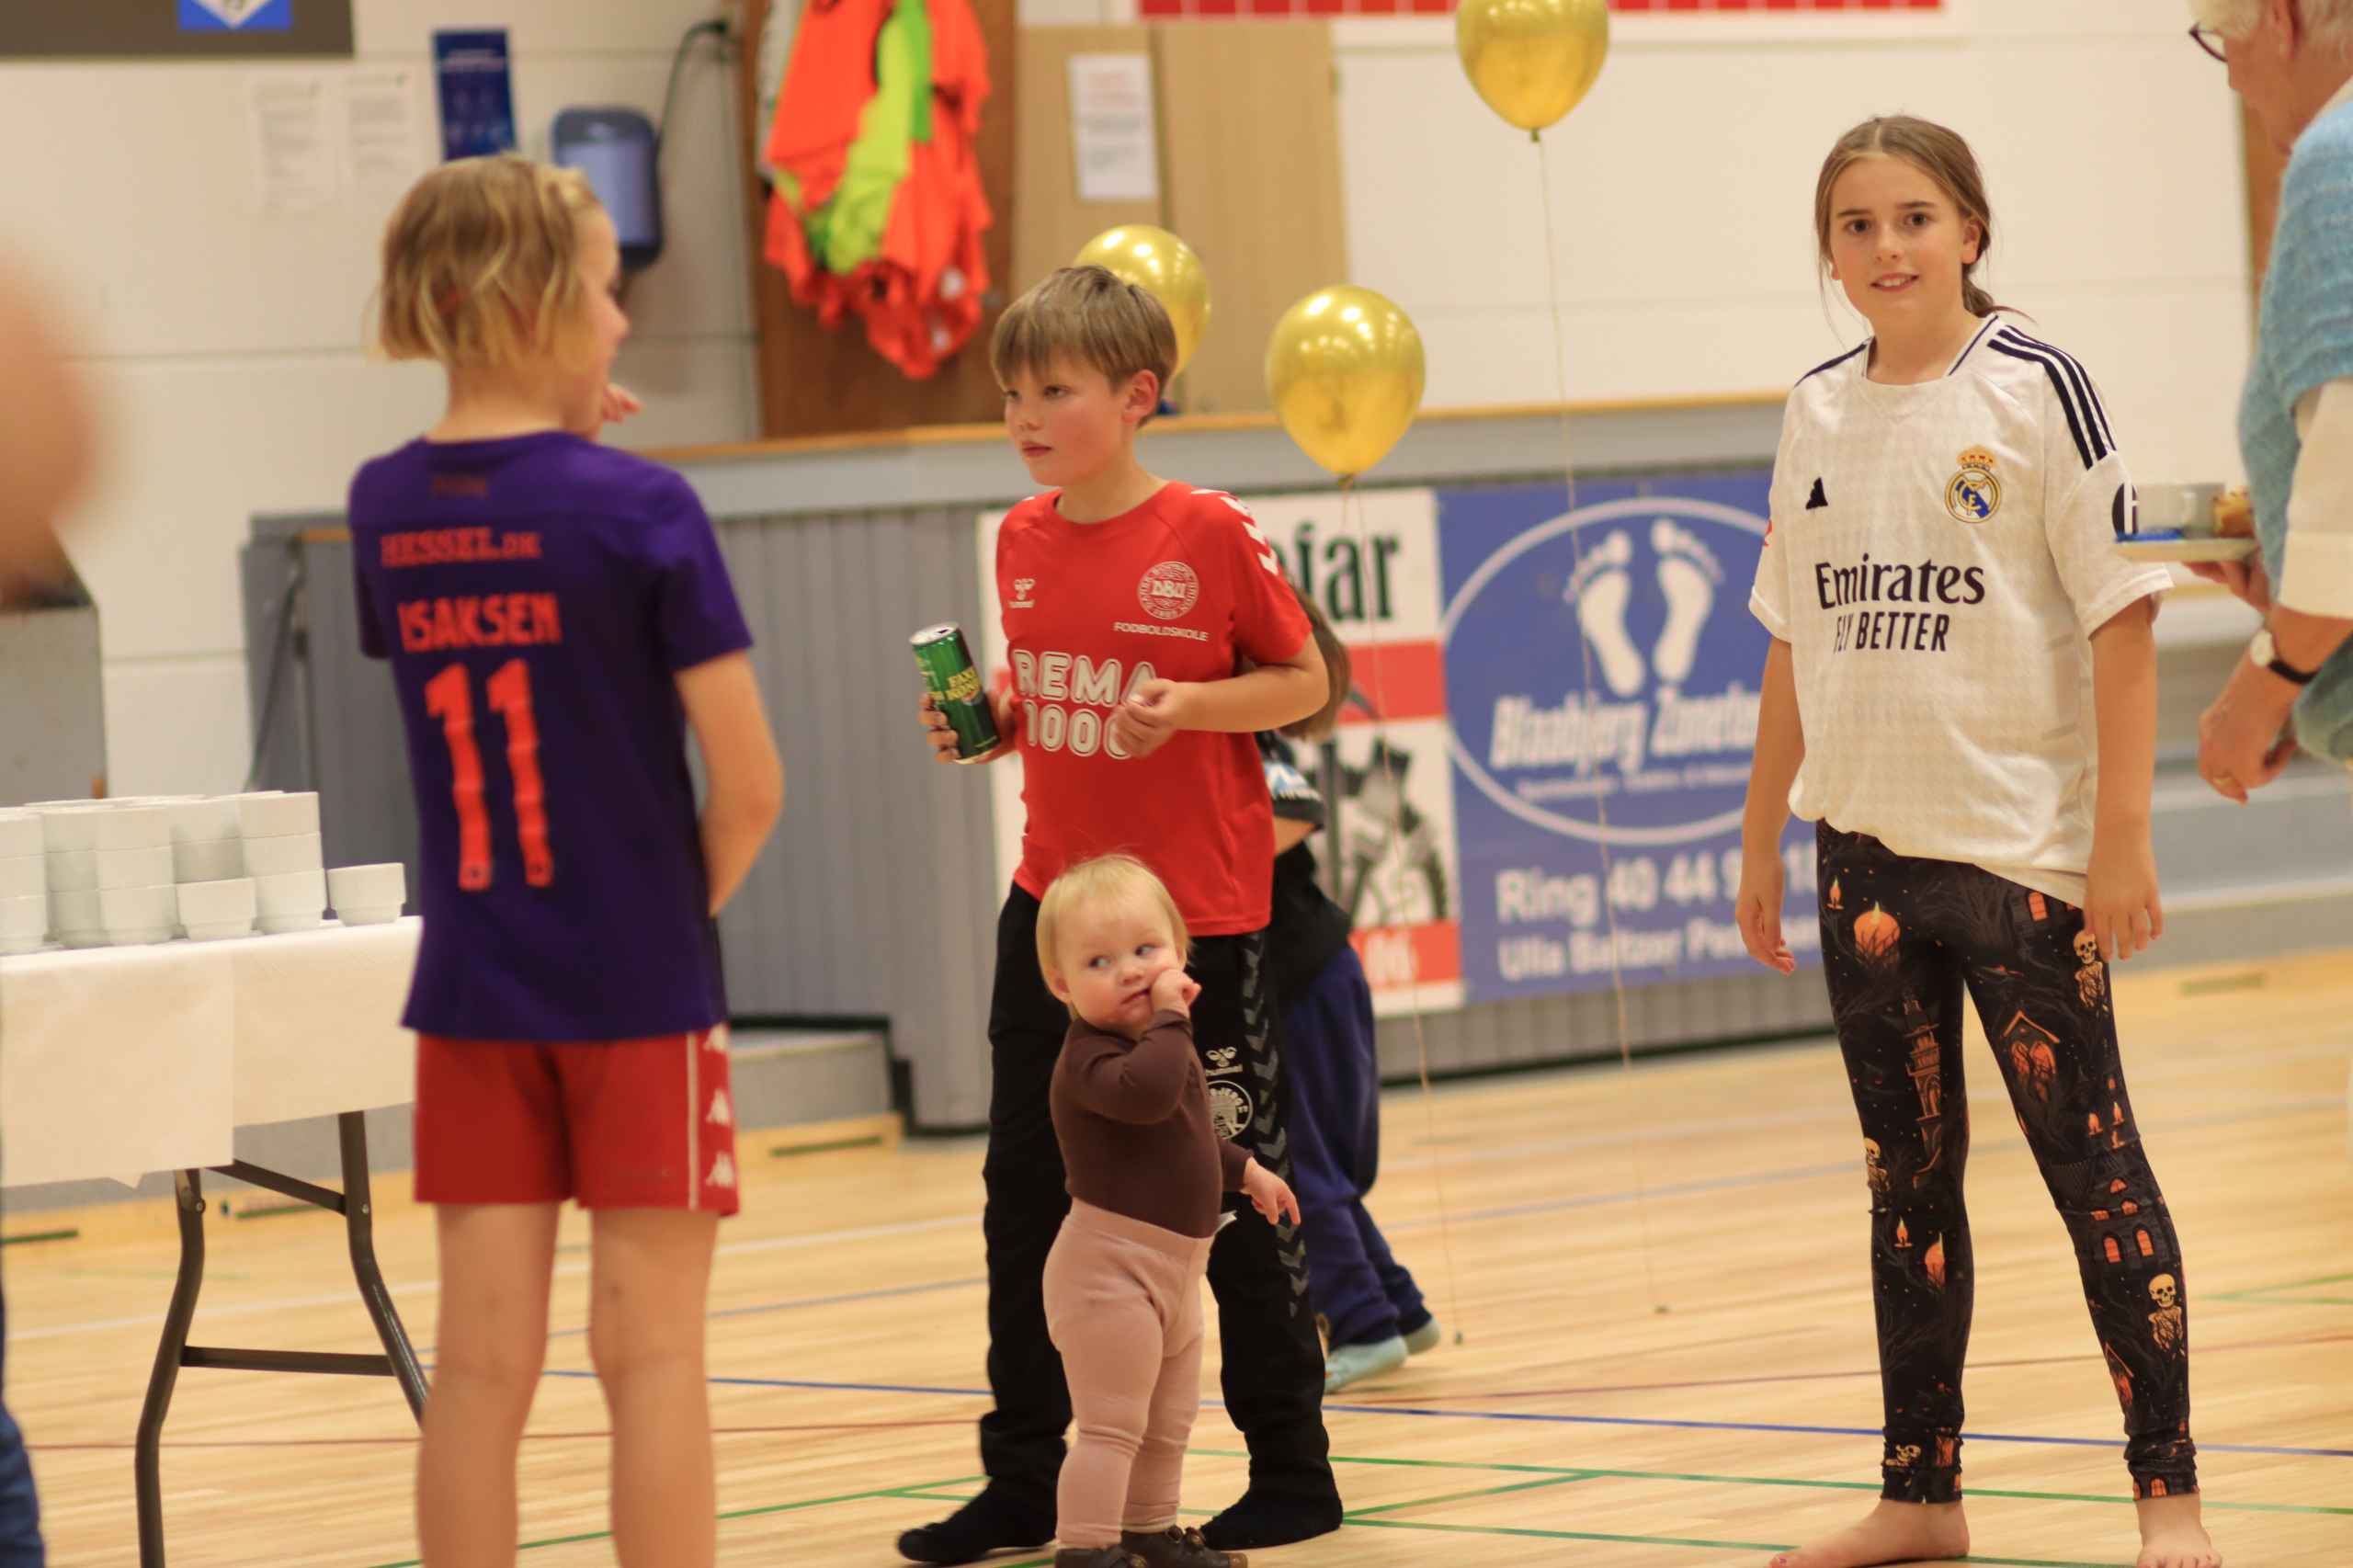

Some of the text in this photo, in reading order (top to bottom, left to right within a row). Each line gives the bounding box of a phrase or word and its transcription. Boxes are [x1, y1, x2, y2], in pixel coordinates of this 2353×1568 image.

[1815, 552, 1985, 609] Emirates
[397, 592, 563, 653] ISAKSEN
[1113, 621, 1210, 642] FODBOLDSKOLE
[1856, 611, 1950, 652] BETTER
[424, 658, 553, 890] 11
[1495, 867, 1599, 926] Ring
